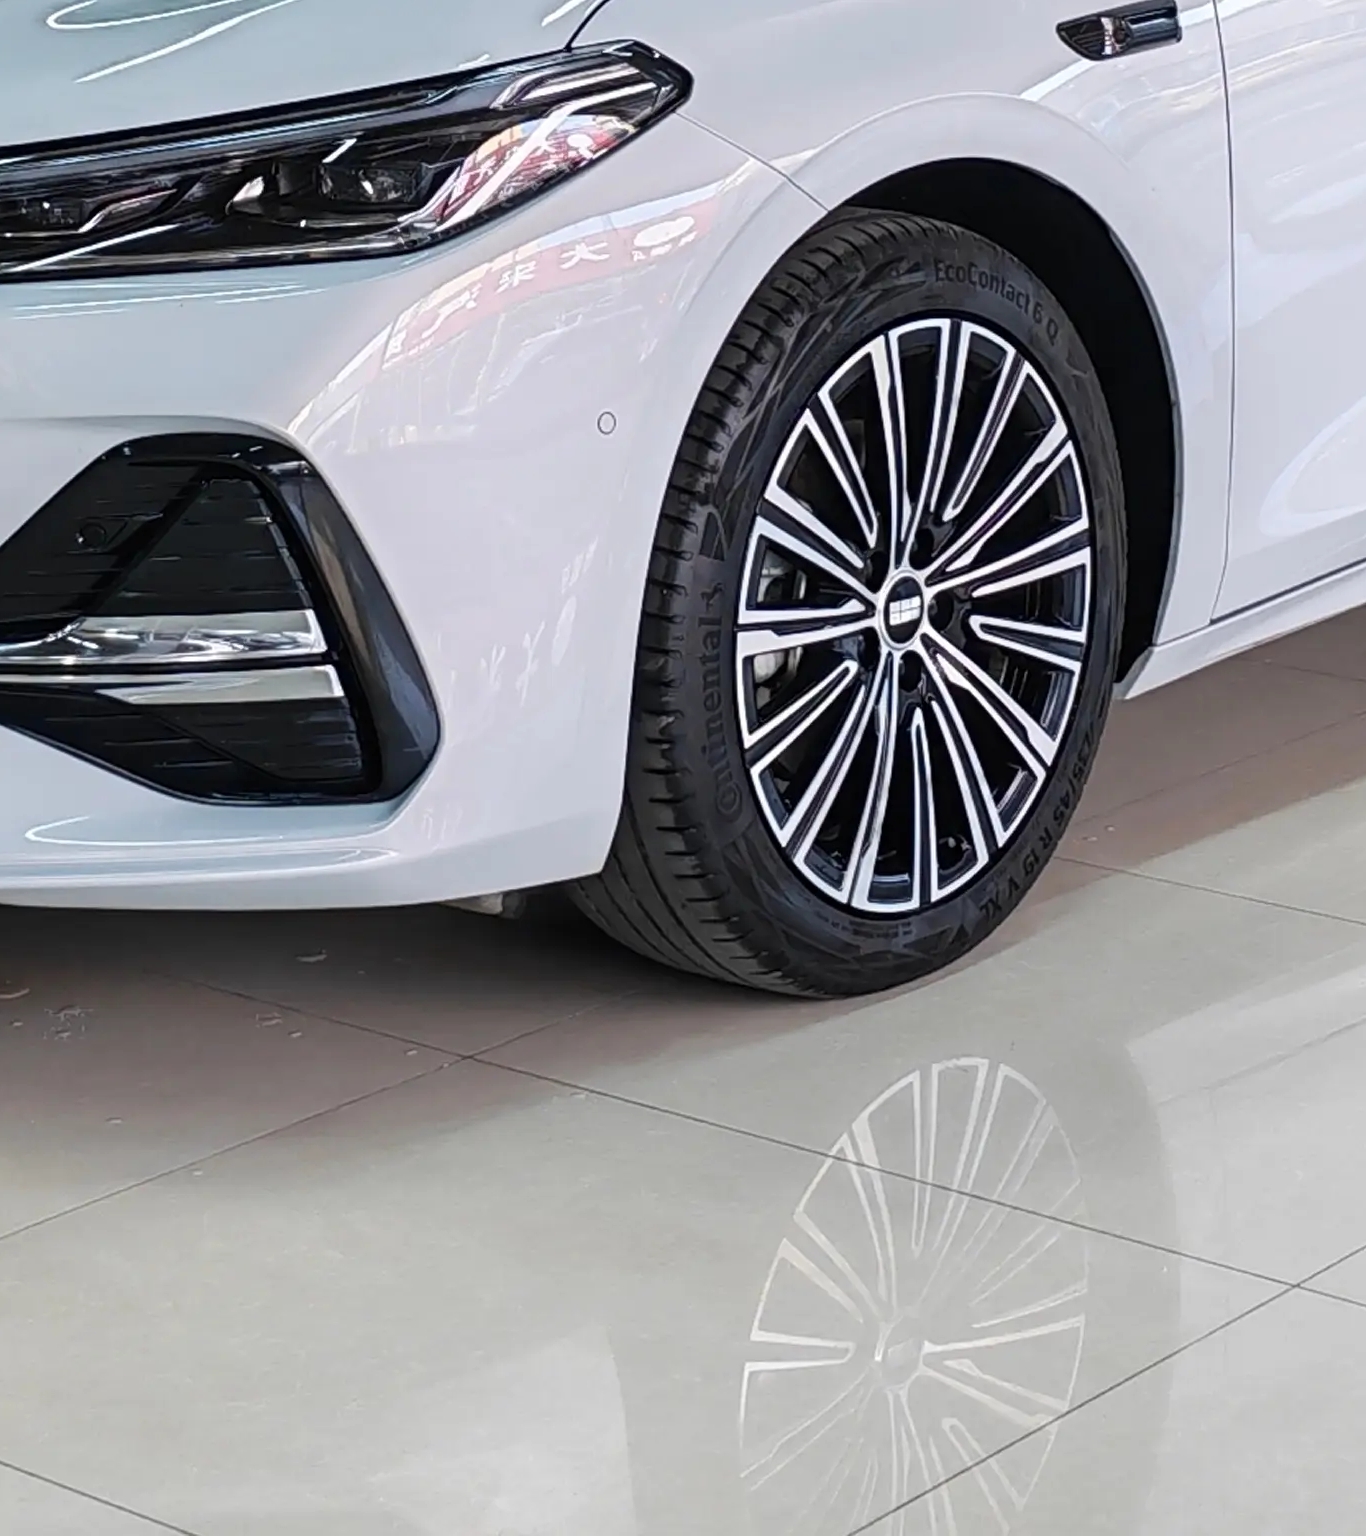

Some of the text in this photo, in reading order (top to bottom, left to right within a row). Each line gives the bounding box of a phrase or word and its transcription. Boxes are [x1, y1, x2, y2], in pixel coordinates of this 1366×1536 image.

[934, 257, 1059, 347] EcoContact 6 Q
[698, 616, 743, 819] Continental
